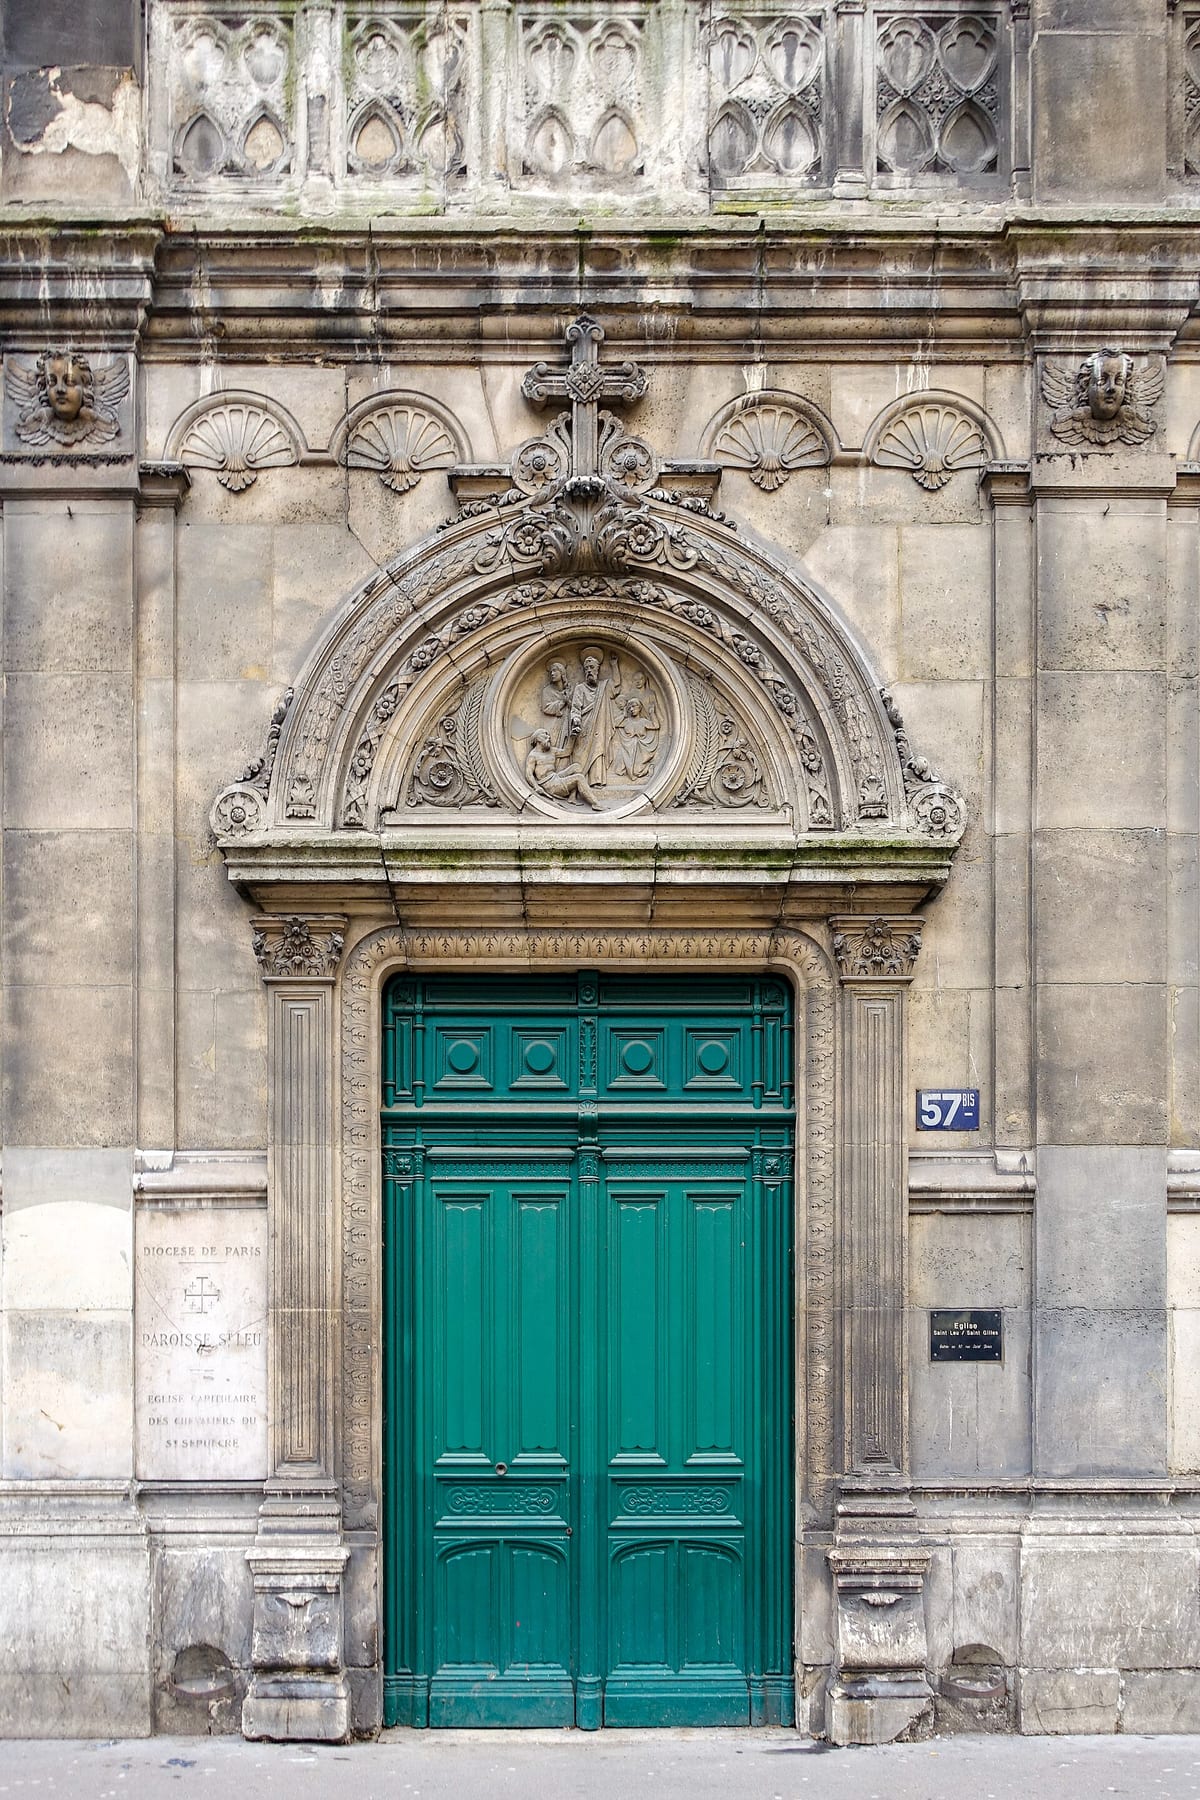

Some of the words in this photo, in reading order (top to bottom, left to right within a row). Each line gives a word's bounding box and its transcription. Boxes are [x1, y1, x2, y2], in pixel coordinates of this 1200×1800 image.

[921, 1093, 962, 1126] 57
[962, 1093, 975, 1107] BIS
[143, 1246, 195, 1257] DIOCESE
[201, 1246, 217, 1257] DE
[225, 1246, 261, 1257] PARIS
[954, 1322, 978, 1330] Eglise
[142, 1333, 210, 1347] PAROISSE
[236, 1333, 261, 1347] LEU
[148, 1395, 184, 1404] EGLISE
[148, 1417, 168, 1425] DES
[242, 1417, 257, 1425] DU
